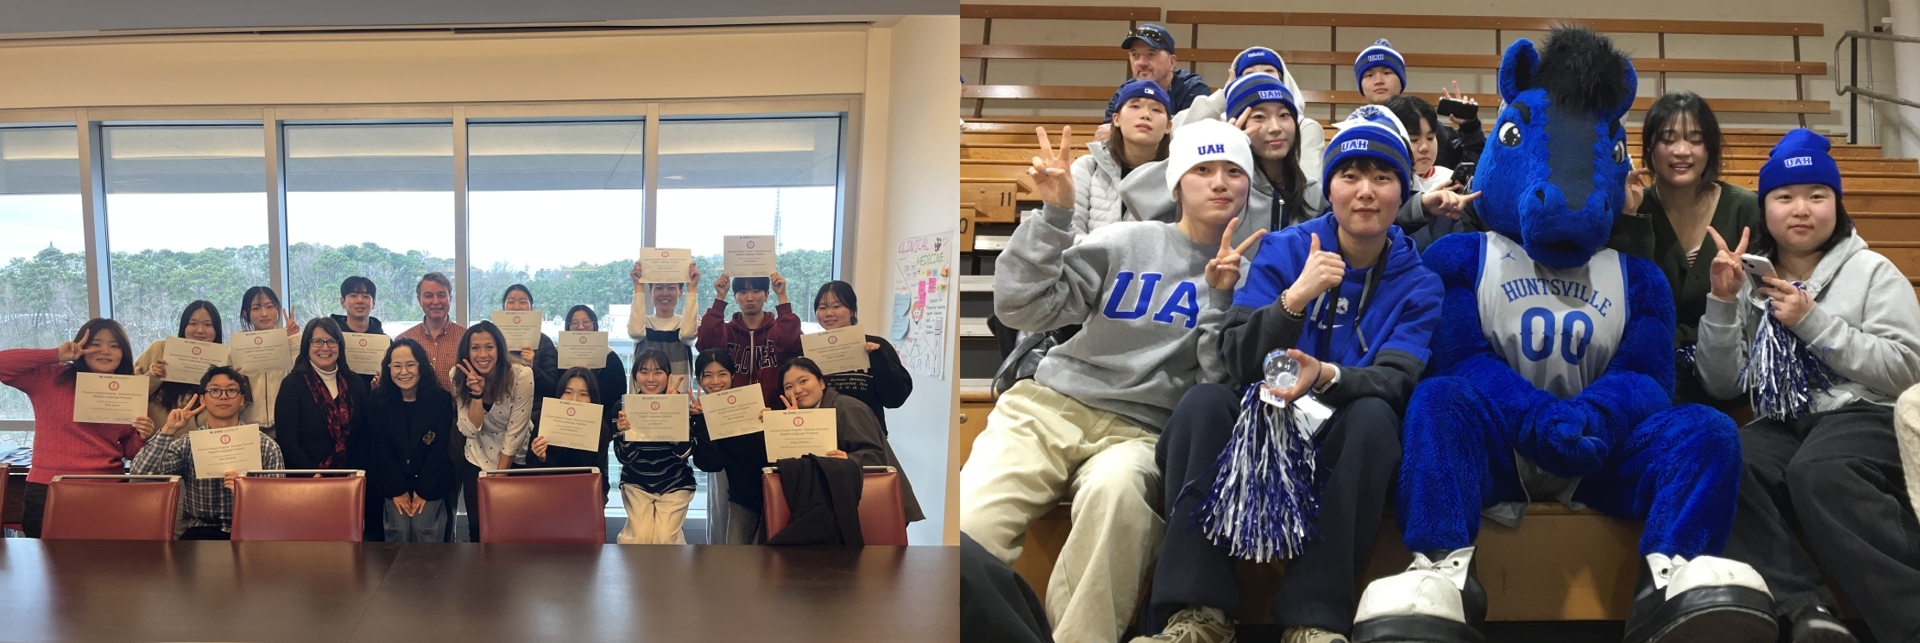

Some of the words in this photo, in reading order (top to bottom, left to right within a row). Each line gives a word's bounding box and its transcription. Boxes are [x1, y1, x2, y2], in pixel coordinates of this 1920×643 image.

[1258, 90, 1283, 99] UAH
[1197, 144, 1225, 155] UAH
[1341, 139, 1368, 152] UAH
[1784, 156, 1813, 168] UAH
[1000, 191, 1011, 207] 11
[1501, 277, 1612, 318] HUNTSVILLE
[1520, 307, 1594, 365] 00
